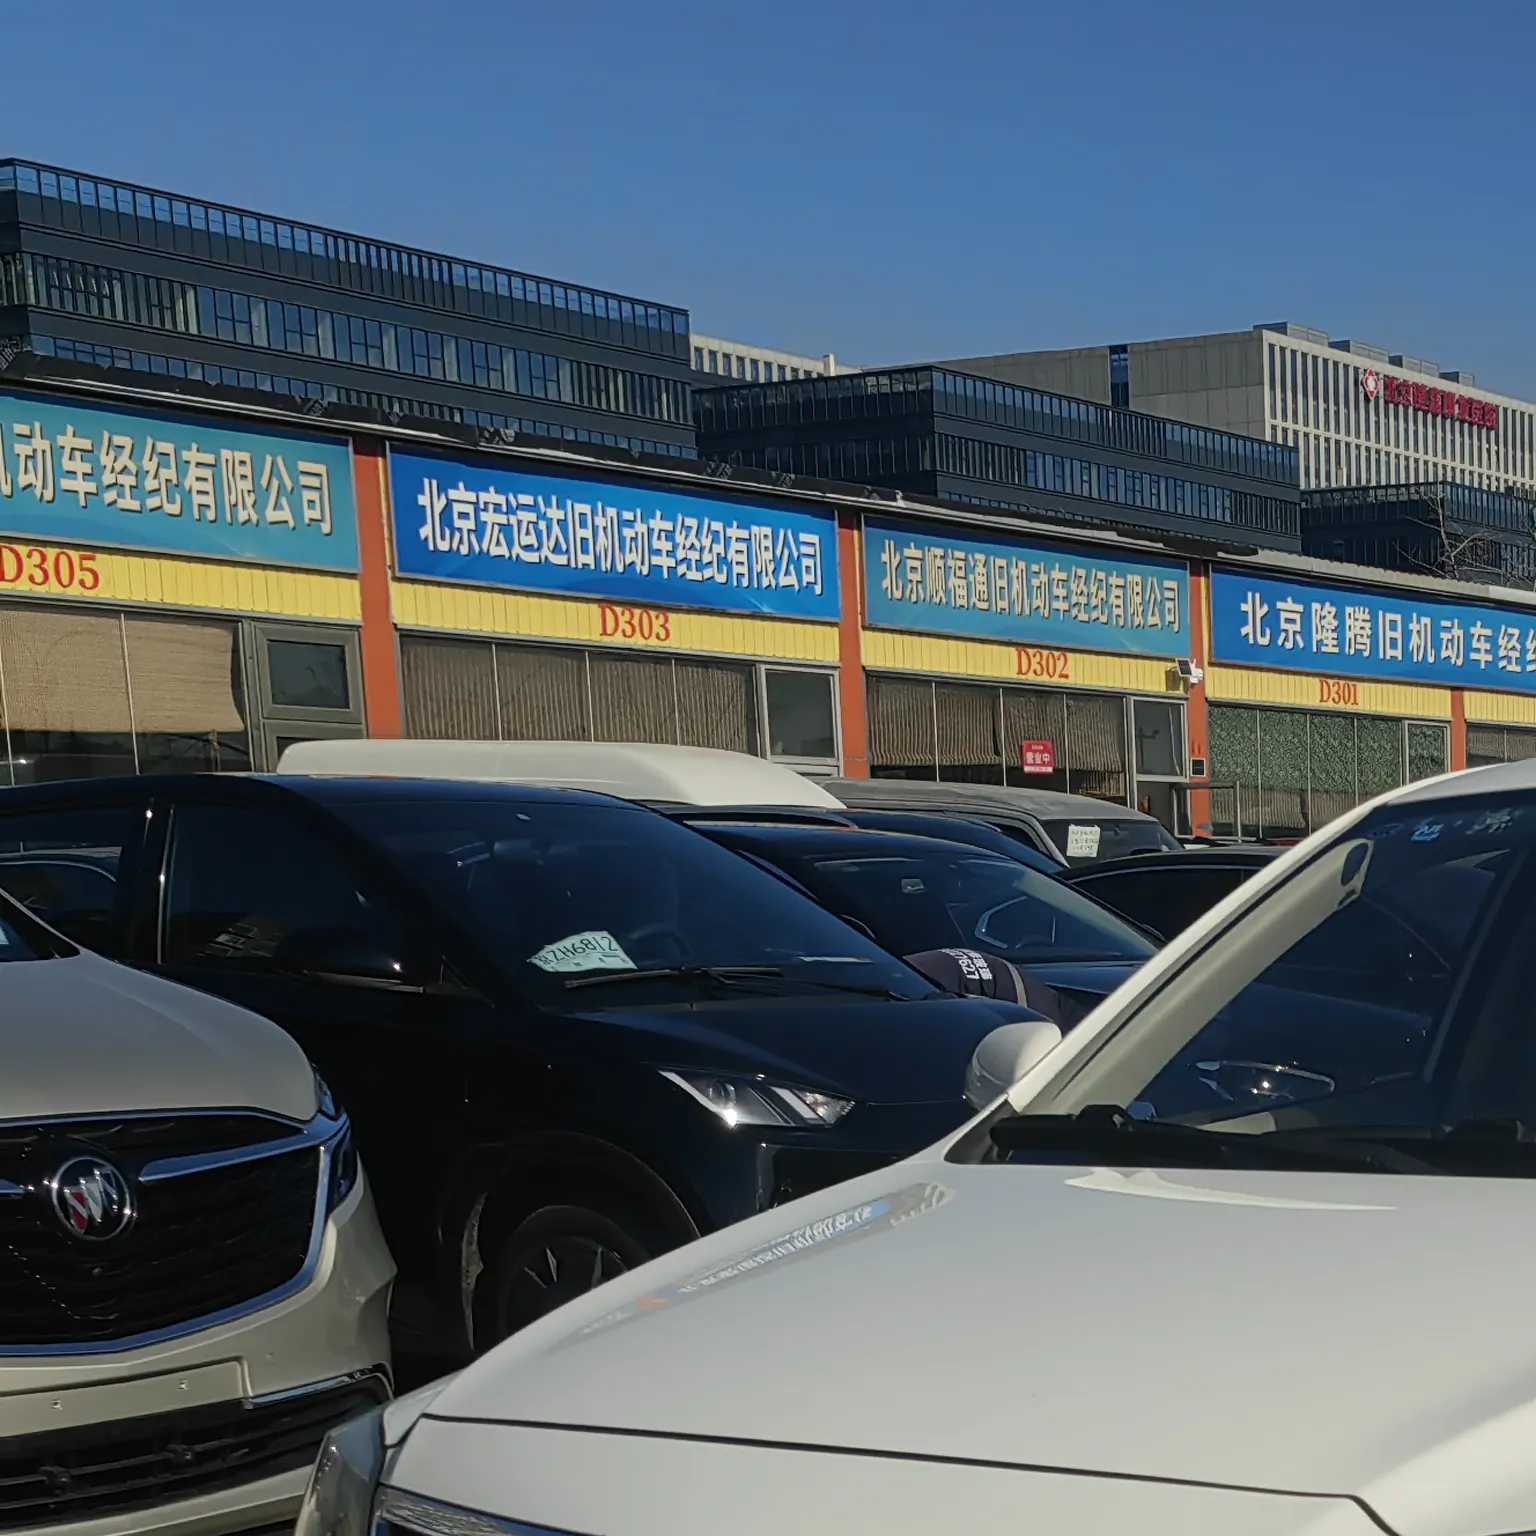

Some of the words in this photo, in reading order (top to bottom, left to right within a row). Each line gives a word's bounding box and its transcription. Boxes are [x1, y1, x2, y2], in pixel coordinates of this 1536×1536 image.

[416, 477, 824, 597] 北京宏运达旧机动车经纪有限公司
[0, 543, 101, 591] D305
[880, 538, 1181, 633] 北京顺福通旧机动车经纪有限公司
[599, 603, 671, 642] D303
[1015, 647, 1070, 681] D302
[1318, 677, 1359, 707] D301
[1025, 752, 1050, 764] 营业中
